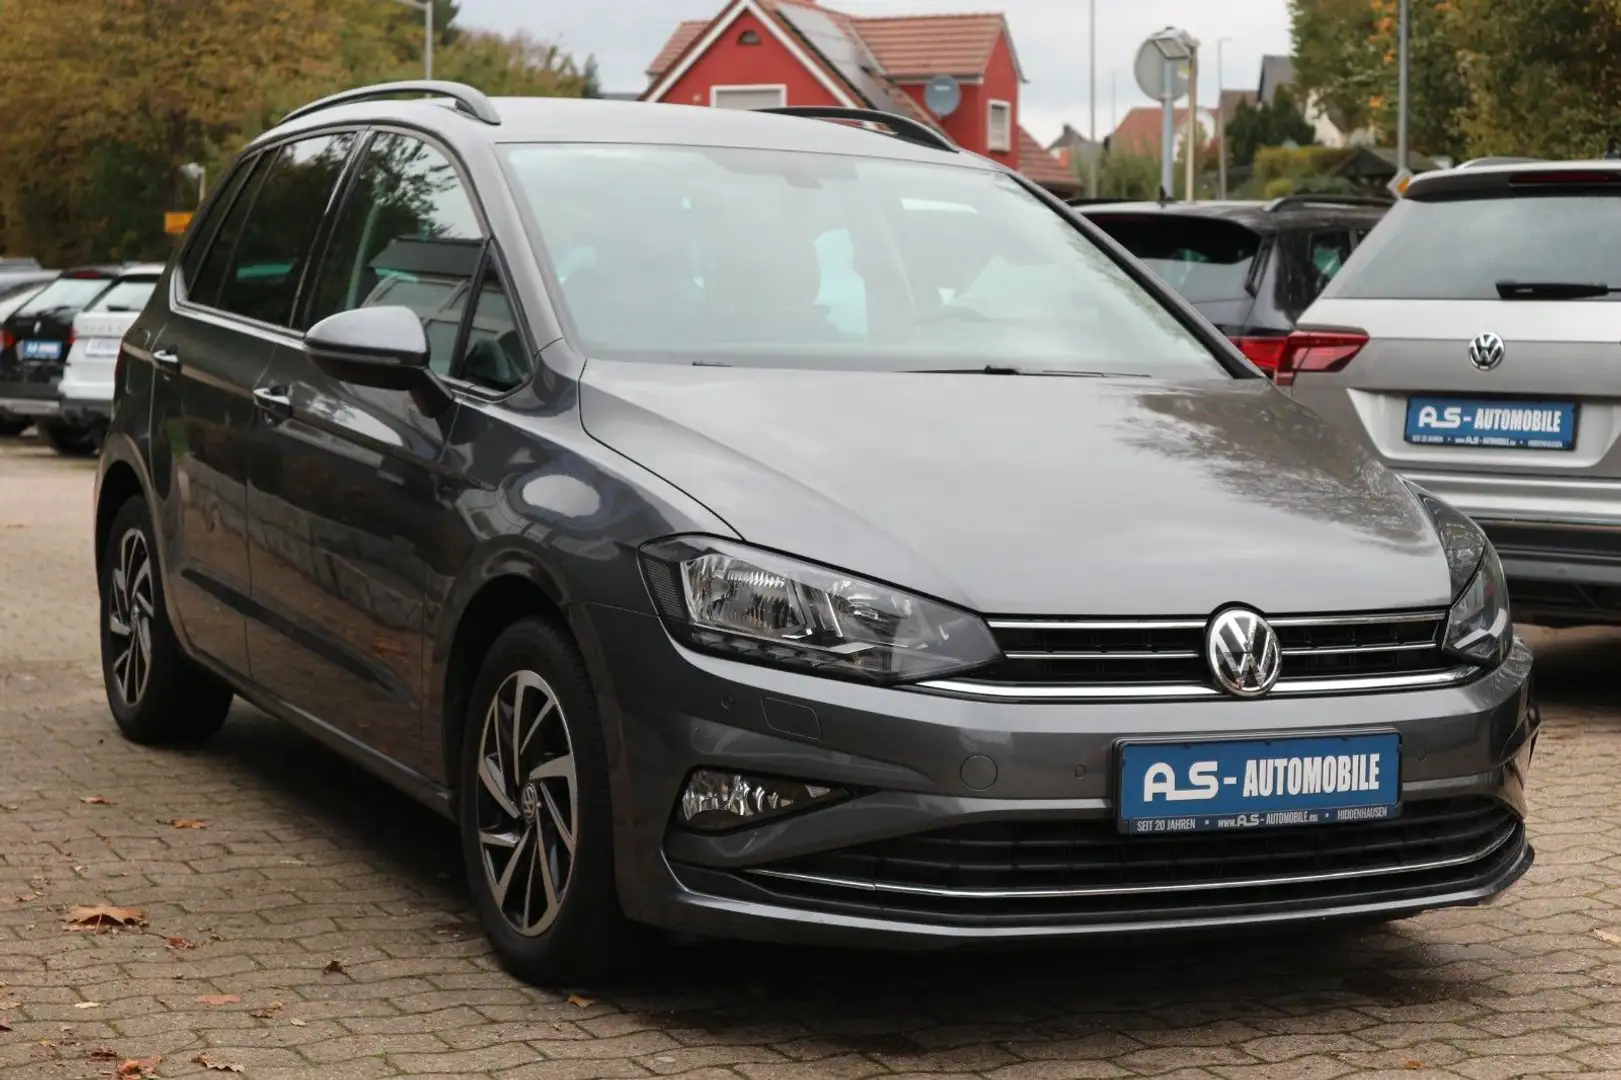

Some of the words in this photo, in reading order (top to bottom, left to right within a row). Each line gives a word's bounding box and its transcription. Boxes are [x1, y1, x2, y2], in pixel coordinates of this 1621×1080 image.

[1137, 820, 1153, 832] SEIT
[1154, 819, 1166, 831] 20
[1167, 818, 1196, 830] JAHREN
[1337, 807, 1388, 821] HIDDENHAUSEN
